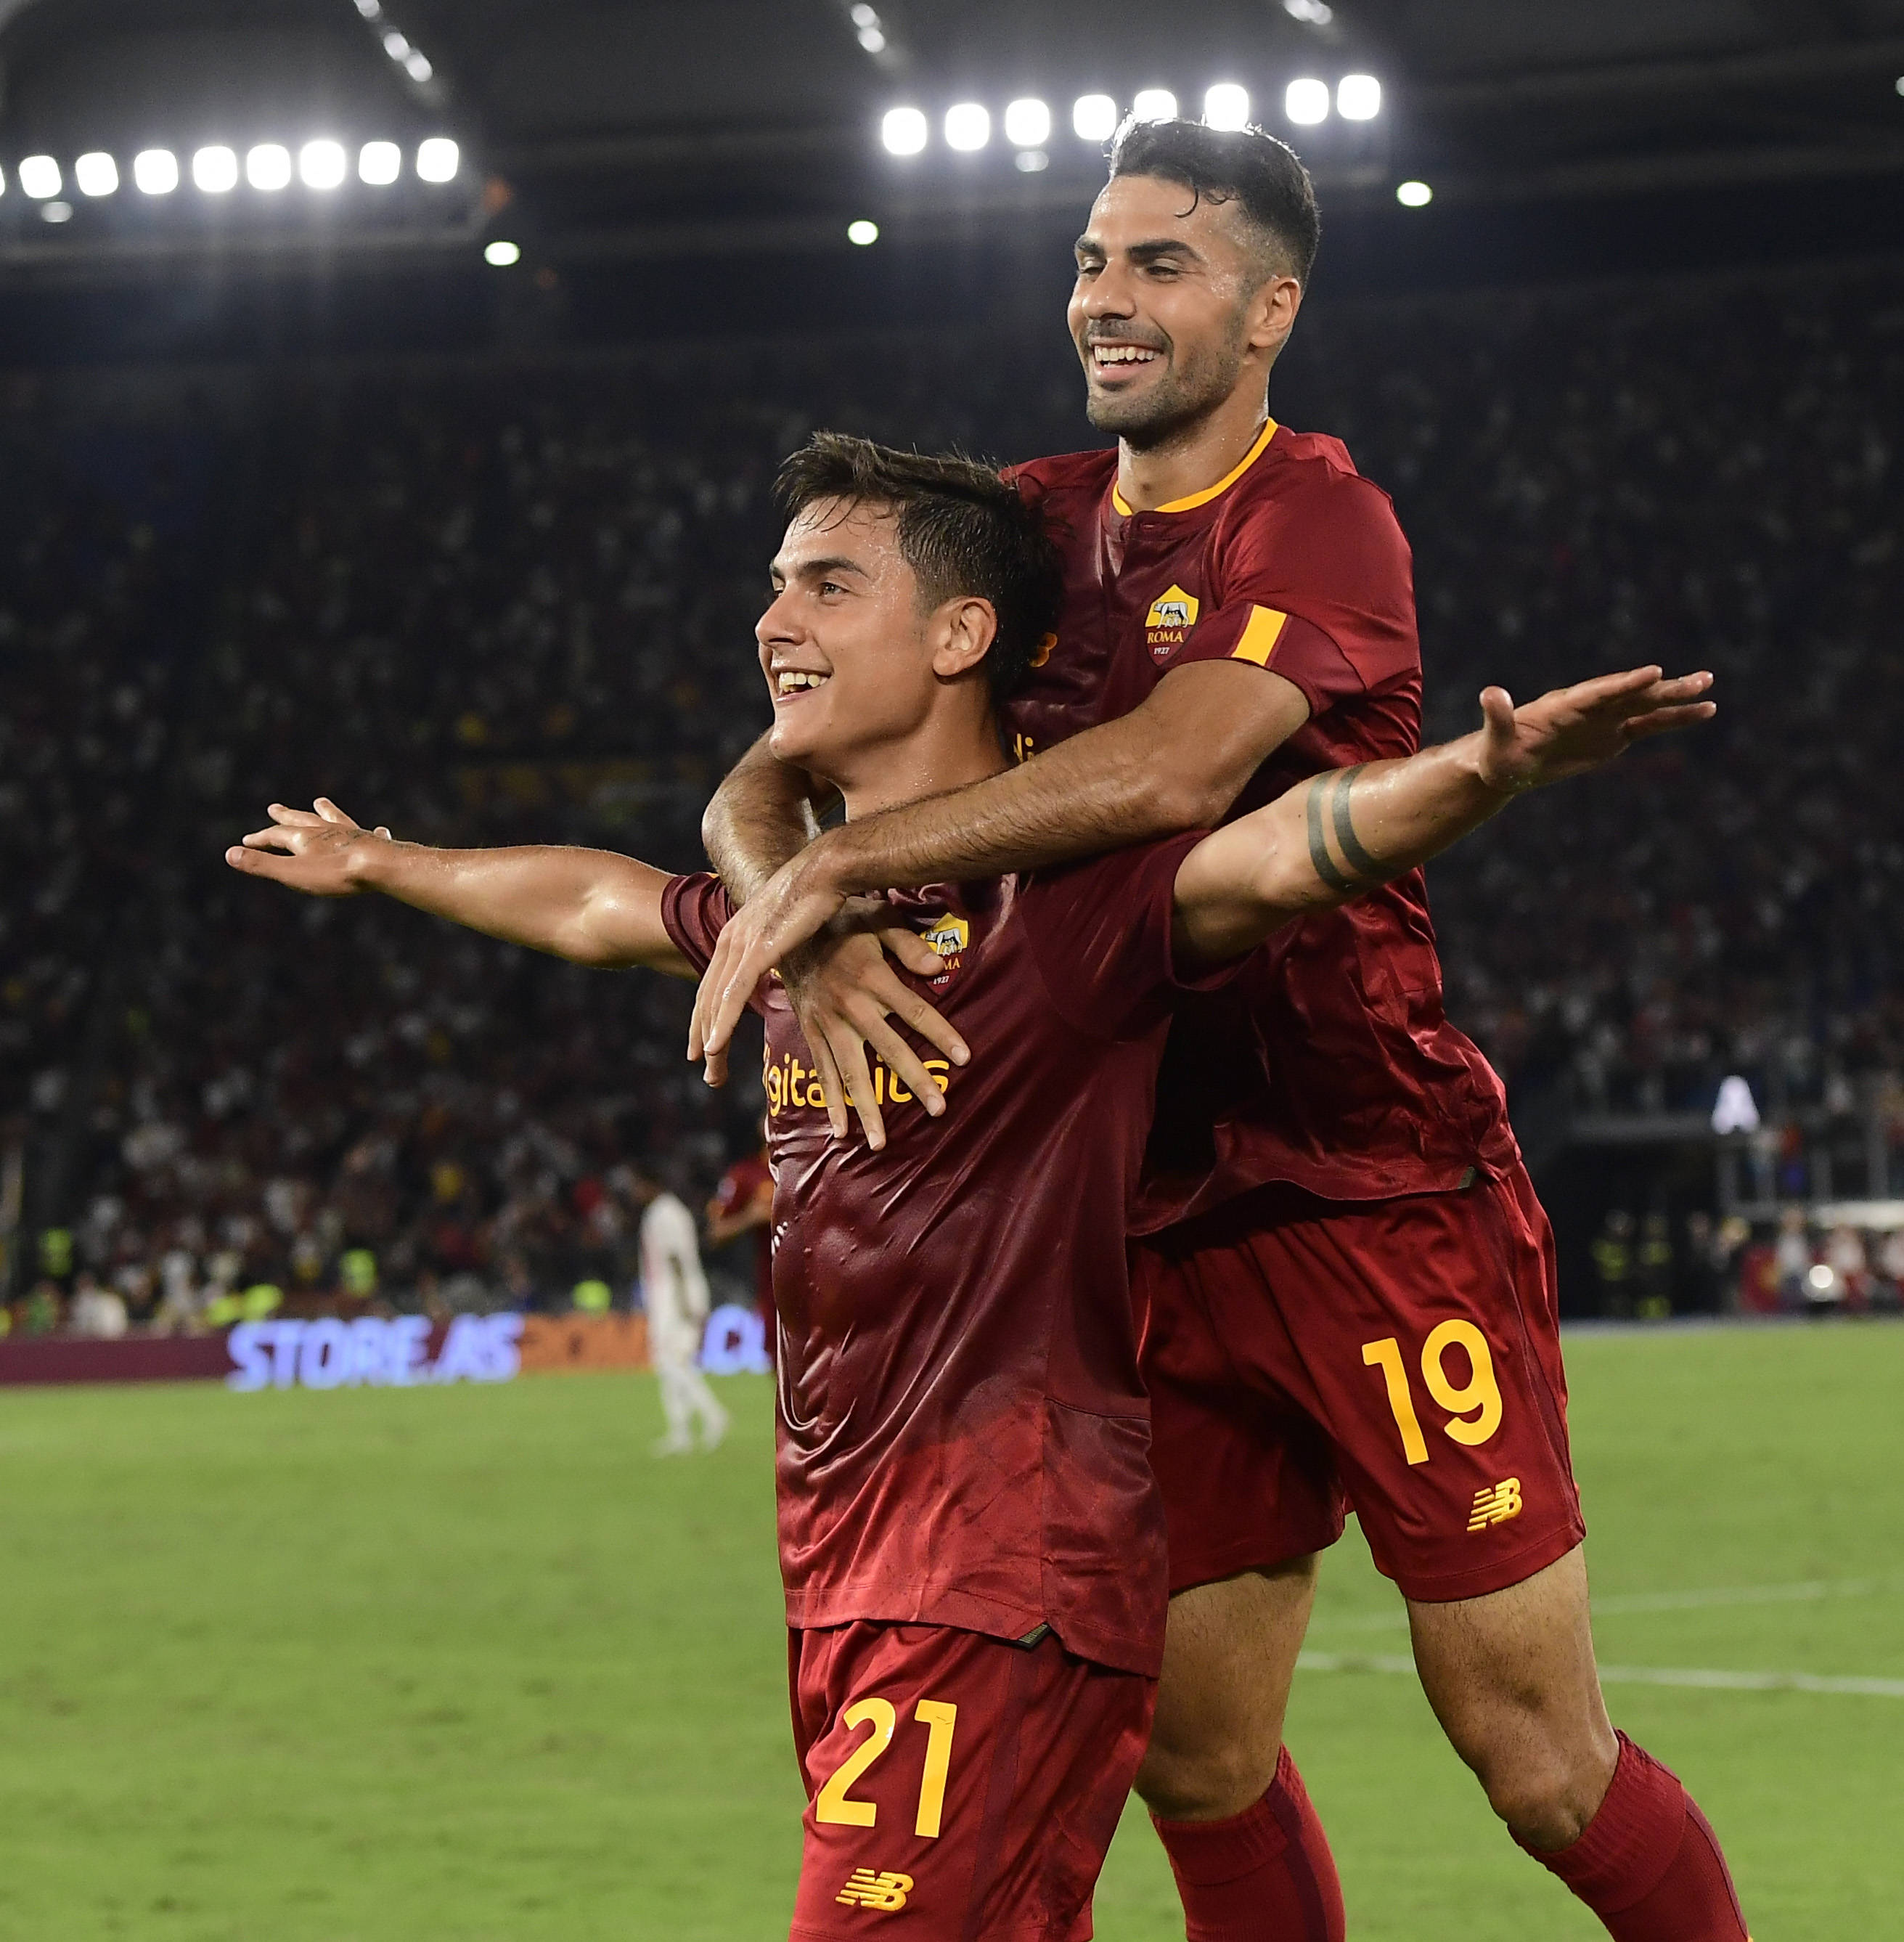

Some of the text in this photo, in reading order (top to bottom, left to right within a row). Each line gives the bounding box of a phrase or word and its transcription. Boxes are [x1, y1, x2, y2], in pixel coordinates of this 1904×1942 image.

[1147, 631, 1184, 644] ROMA
[943, 958, 960, 970] MA
[933, 976, 950, 985] 1927
[1361, 1318, 1503, 1465] 19
[816, 1697, 957, 1838] 21
